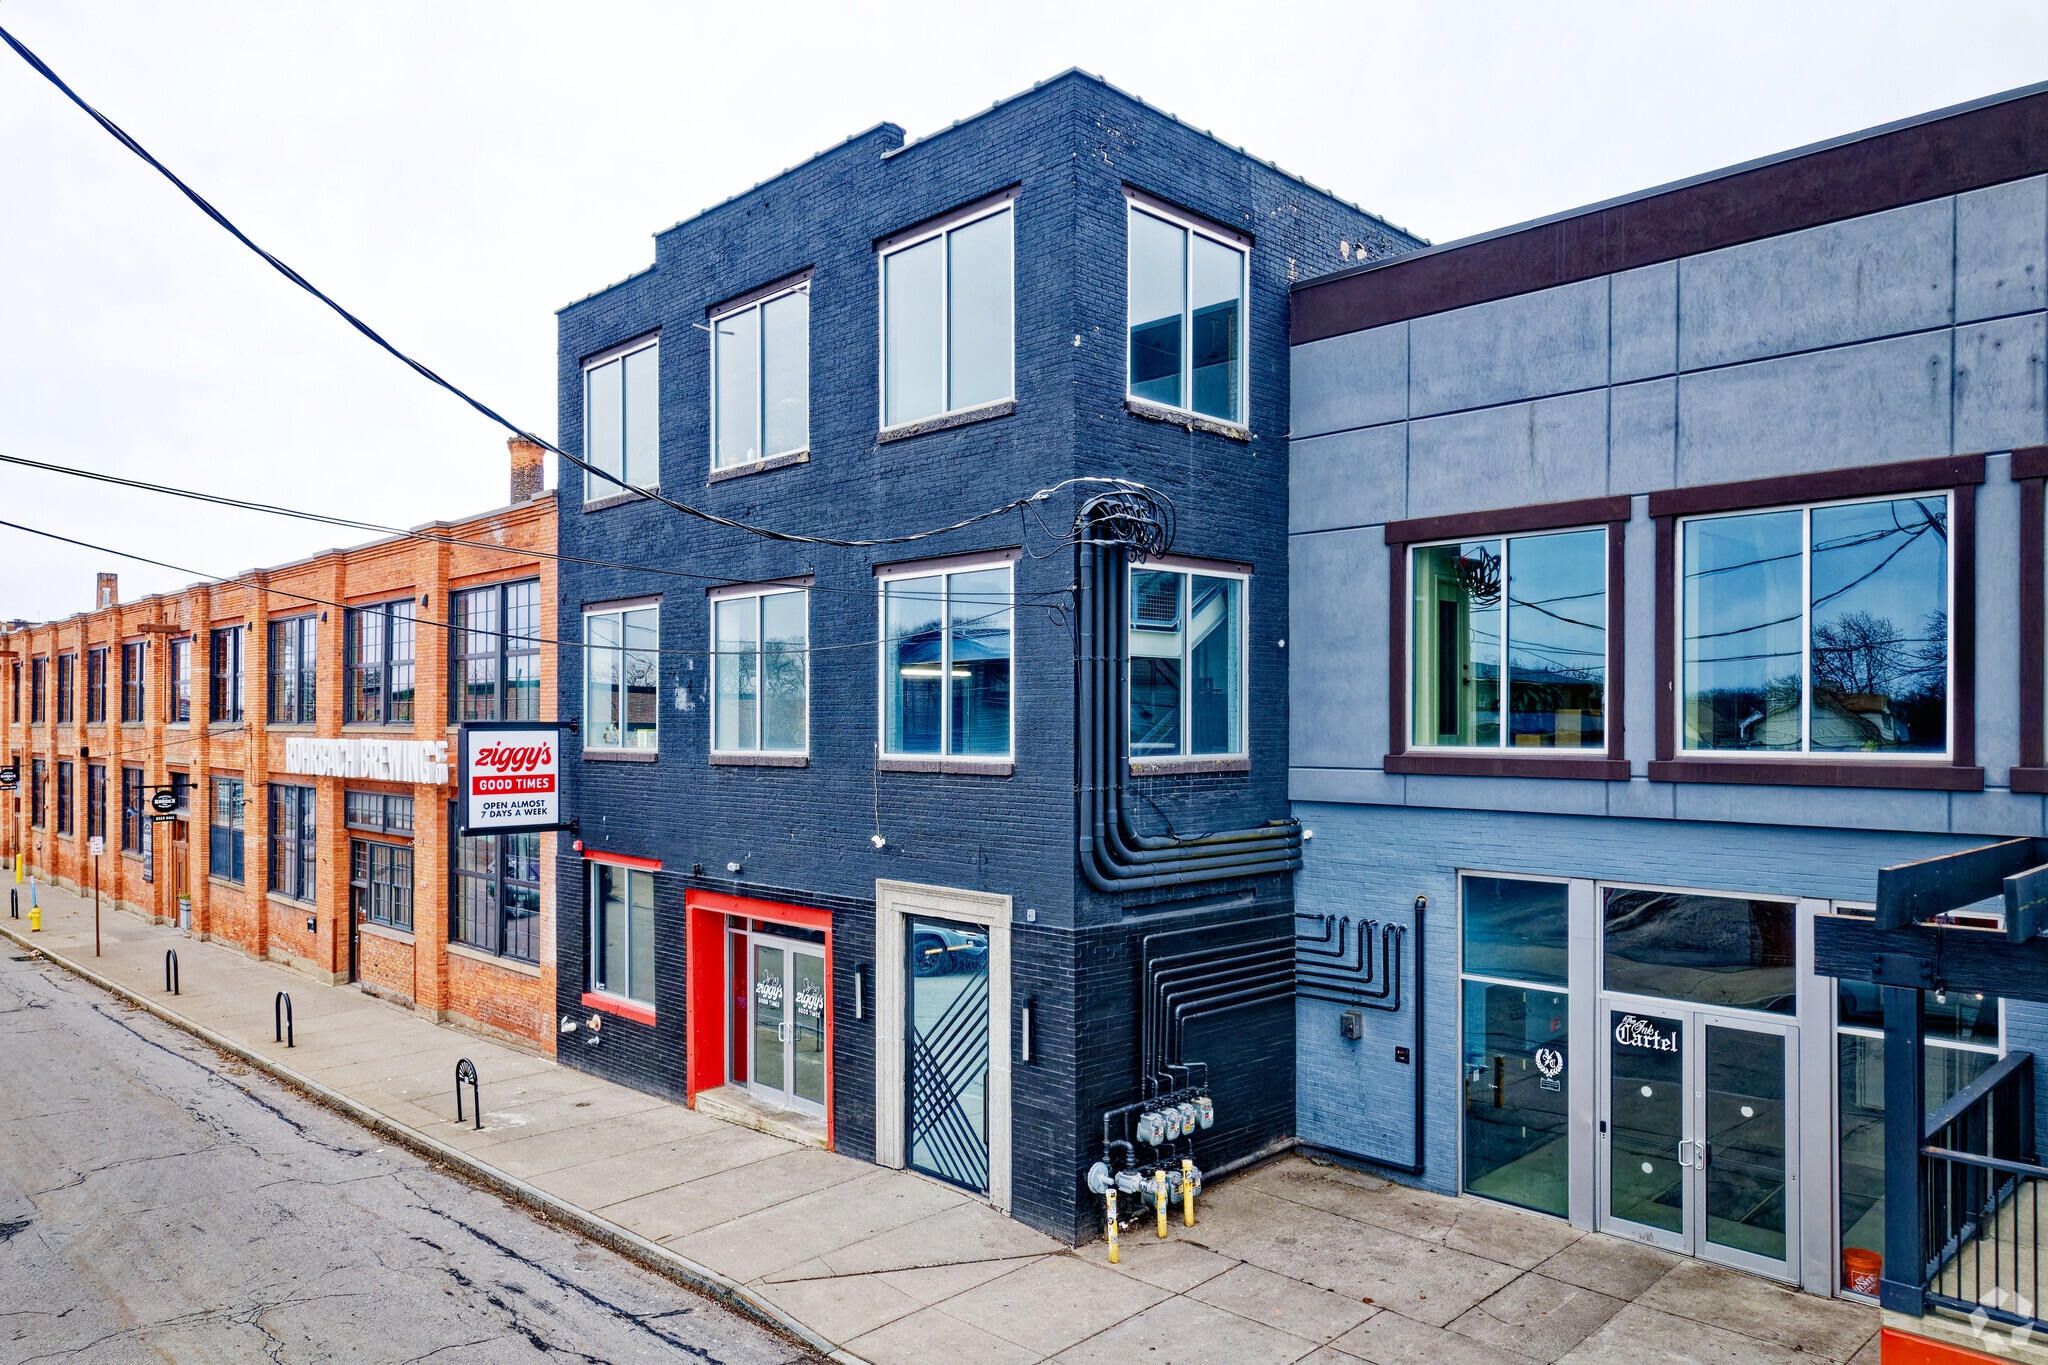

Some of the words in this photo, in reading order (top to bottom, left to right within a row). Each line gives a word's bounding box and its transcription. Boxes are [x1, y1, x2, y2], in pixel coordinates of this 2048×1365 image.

[286, 737, 355, 777] ROHRBACH
[360, 738, 436, 784] BREWING
[475, 740, 551, 773] ziggy's
[479, 779, 512, 791] GOOD
[516, 777, 549, 789] TIMES
[481, 810, 487, 818] 7
[489, 809, 512, 818] DAYS
[524, 807, 548, 816] WEEK
[483, 801, 508, 810] OPEN
[511, 799, 545, 809] ALMOST
[756, 980, 783, 1000] ziggy's
[758, 997, 769, 1005] GOOD
[769, 1000, 780, 1008] TIMES
[795, 989, 824, 1011] ziggy's
[797, 1007, 809, 1015] GOOD
[1615, 1022, 1678, 1053] Cartel
